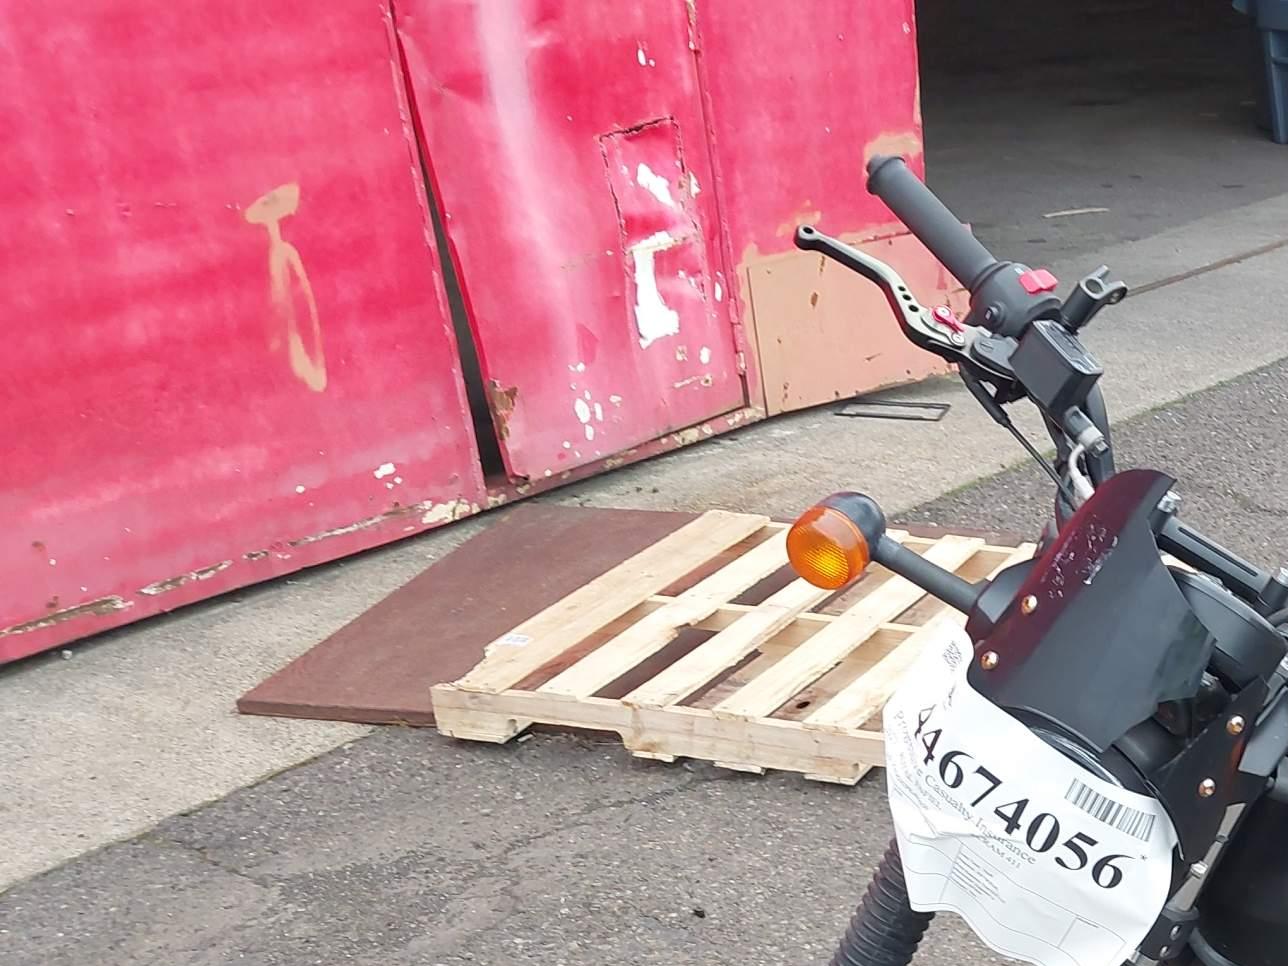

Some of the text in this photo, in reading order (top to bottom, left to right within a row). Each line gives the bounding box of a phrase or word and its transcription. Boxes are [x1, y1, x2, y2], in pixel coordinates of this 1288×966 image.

[914, 704, 1136, 890] 44674056
[925, 774, 973, 822] Casualty
[976, 817, 1037, 865] Insurance
